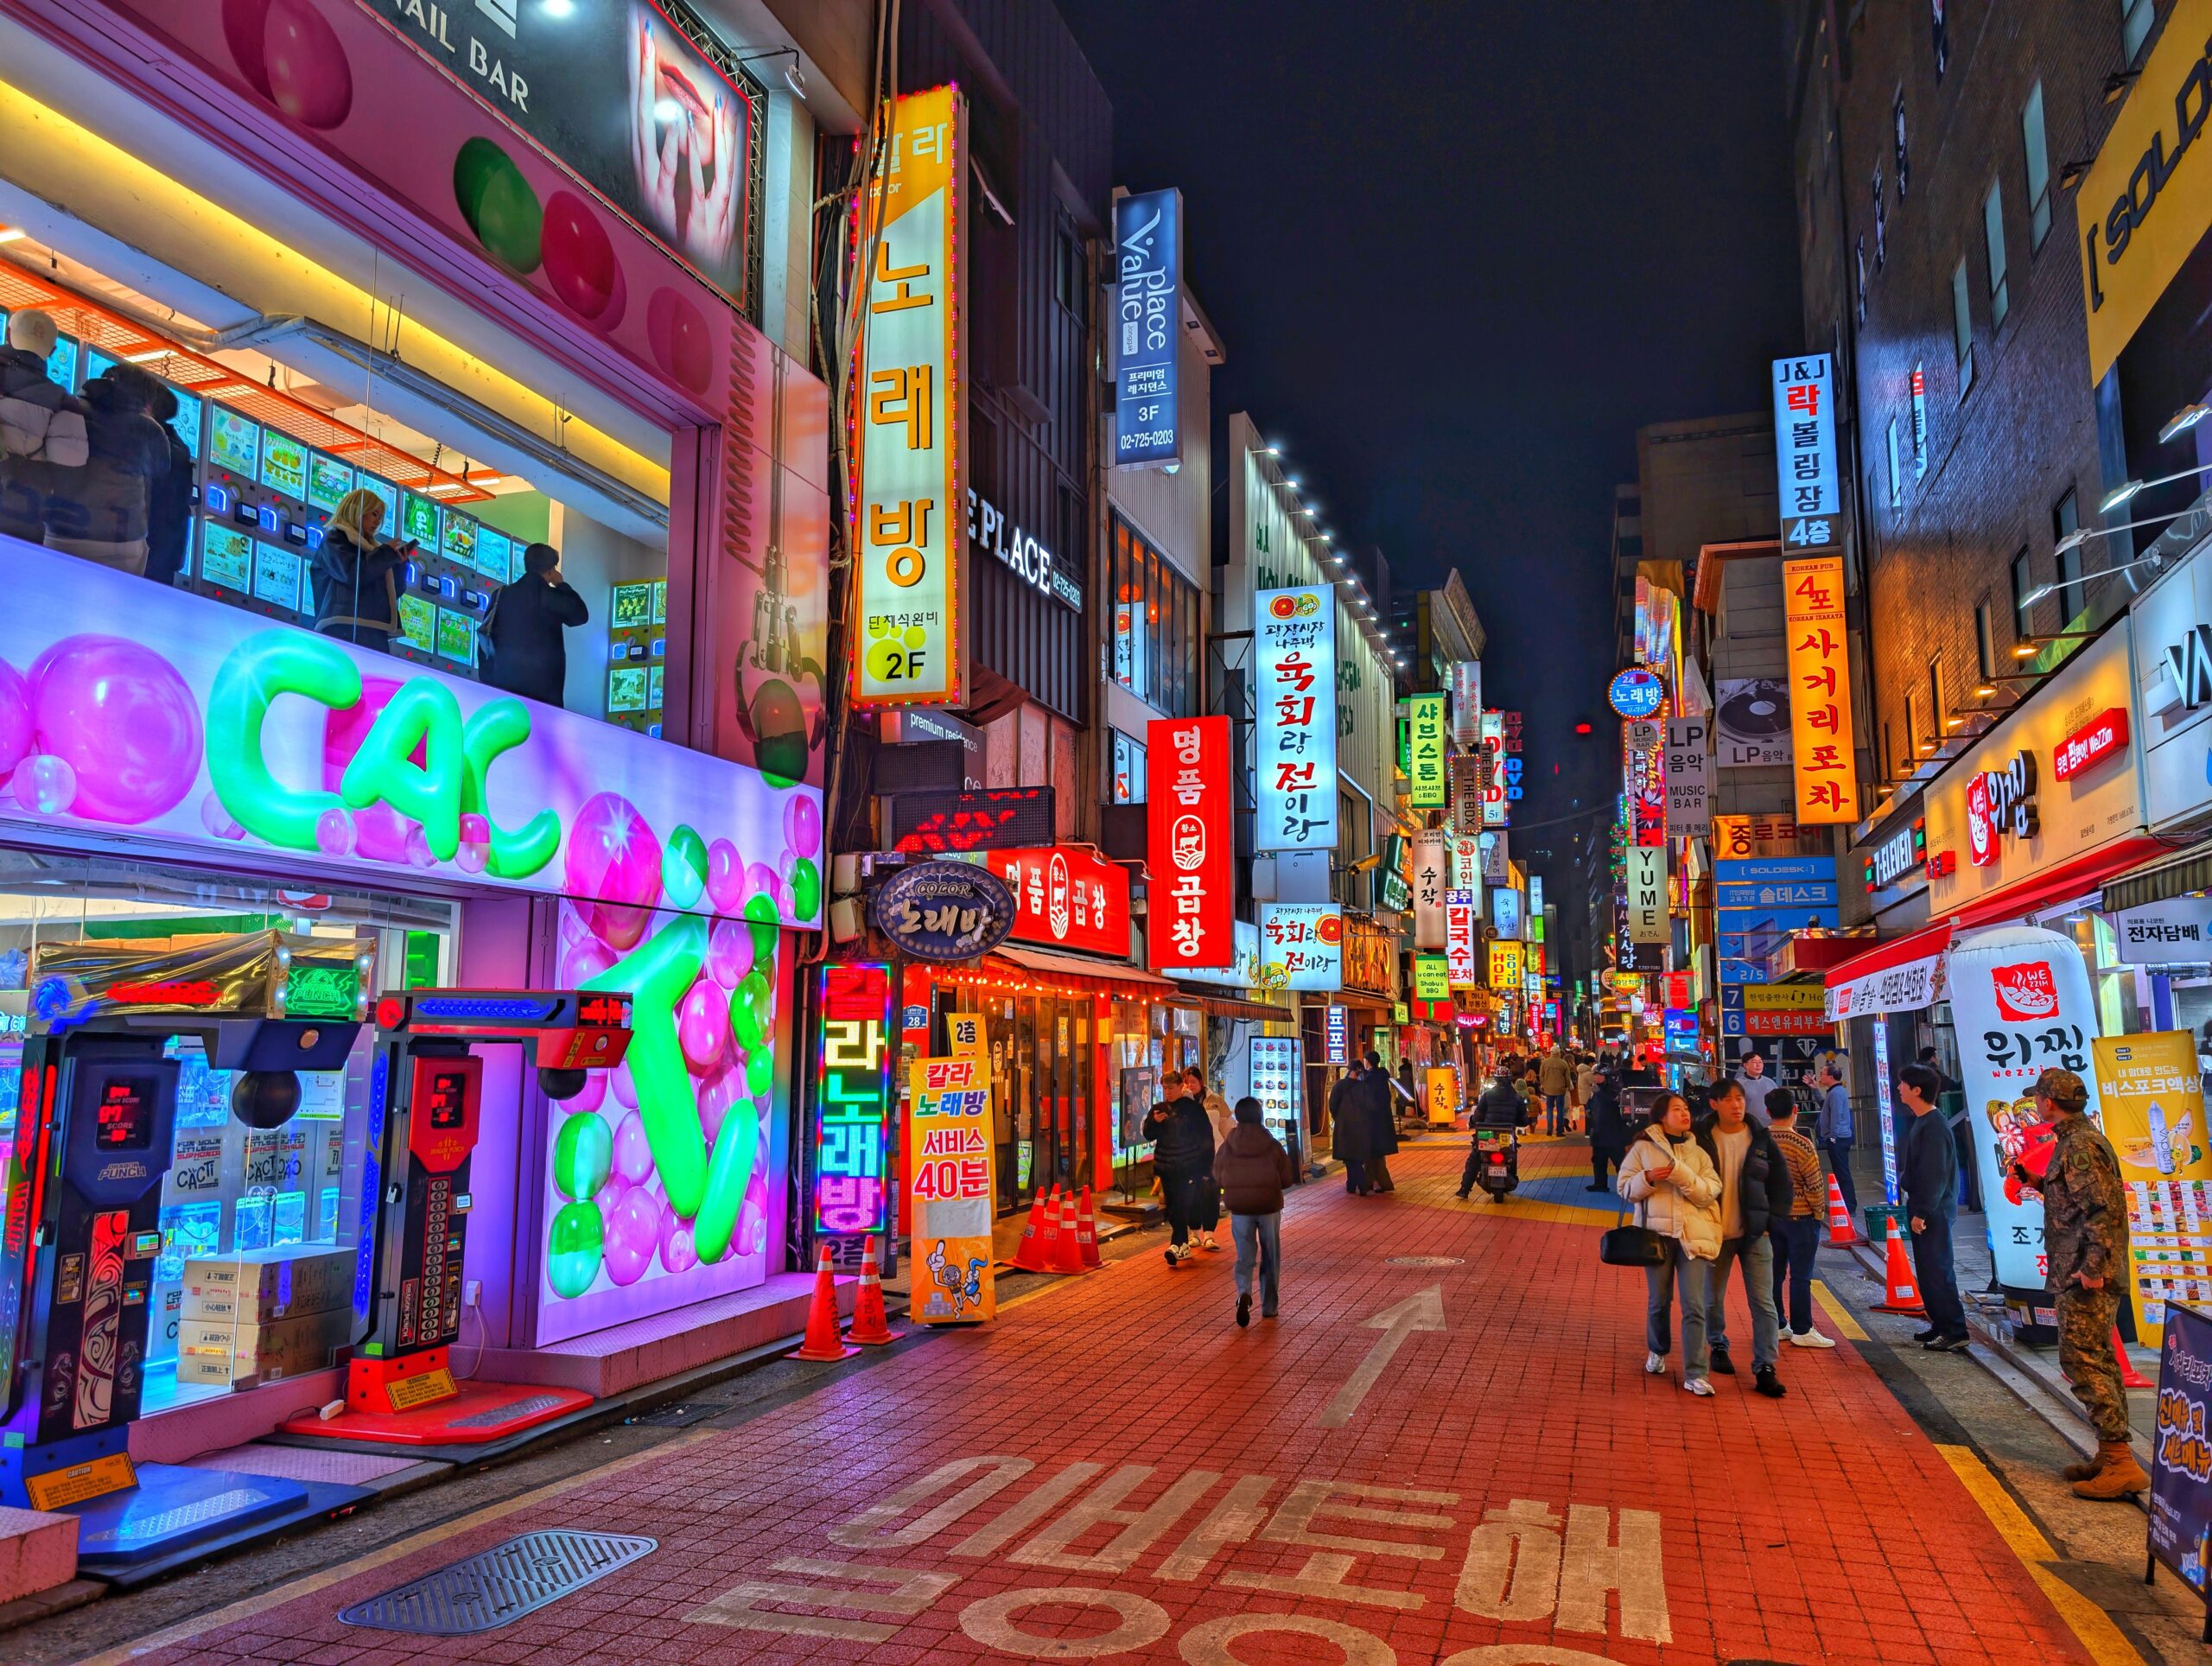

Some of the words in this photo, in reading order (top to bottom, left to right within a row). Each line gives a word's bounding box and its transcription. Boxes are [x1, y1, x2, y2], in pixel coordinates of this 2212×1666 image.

[394, 0, 455, 54] AIL
[468, 36, 530, 113] BAR
[869, 181, 902, 198] coor
[1121, 207, 1161, 321] Value
[1146, 264, 1176, 351] place
[1128, 367, 1166, 383] 프리미엄
[1778, 359, 1826, 384] J&J
[1127, 380, 1168, 396] 레지던스
[870, 239, 935, 588] 노래방
[1138, 404, 1160, 423] 3F
[1120, 429, 1174, 450] 02-725-0203
[1789, 518, 1831, 546] 4층
[979, 499, 1052, 596] PLACE
[1790, 564, 1819, 573] KOREAN
[1052, 570, 1082, 608] 02-725-0203
[868, 610, 939, 631] 단체석완비
[1815, 613, 1845, 621] IZAKAYA
[1265, 620, 1325, 639] 광장시장
[1274, 635, 1316, 649] 나주댁
[885, 651, 927, 680] 2F
[1622, 675, 1635, 685] 24
[1613, 686, 1660, 706] 노래방
[910, 711, 945, 741] premium
[1795, 628, 1850, 813] 사거리포차
[1634, 726, 1651, 737] LP
[1669, 725, 1705, 747] LP
[1417, 703, 1440, 782] 샤브스톤
[1171, 724, 1207, 806] 명품
[1481, 745, 1491, 766] THE
[1668, 754, 1705, 773] 음악
[1732, 747, 1761, 764] LP
[1761, 749, 1784, 762] 음악
[2057, 753, 2069, 777] 우린
[1464, 775, 1475, 798] THE
[1481, 767, 1492, 787] BOX
[1506, 758, 1523, 800] DVD
[1669, 785, 1706, 798] MUSIC
[1464, 802, 1476, 825] BOX
[1674, 797, 1702, 810] BAR
[1487, 810, 1501, 819] 5F
[1179, 823, 1198, 833] 황소
[1873, 828, 1913, 887] 7-ELEVEN
[1459, 857, 1473, 886] 코인
[915, 881, 975, 900] COLOR
[1420, 866, 1439, 907] 수작
[1639, 850, 1656, 926] YUME
[1758, 886, 1828, 904] 솔데스크
[1072, 879, 1107, 931] 곱창
[1446, 891, 1472, 904] 공주
[1170, 874, 1208, 957] 곱창
[1264, 916, 1319, 946] 육회랑
[1447, 907, 1471, 966] 칼국수
[2126, 924, 2200, 944] 전자담배
[1285, 951, 1338, 974] 전이랑
[1493, 953, 1504, 984] HOF
[1506, 953, 1516, 985] SOJU
[1447, 968, 1473, 981] 포차
[2027, 969, 2048, 981] WE
[2029, 979, 2049, 989] ZZIM
[294, 987, 341, 1002] PUNCH
[1727, 990, 1739, 1005] 7
[1749, 993, 1789, 1003] 한림출판사
[908, 1016, 920, 1027] 28
[956, 1020, 976, 1044] 2층
[1668, 1020, 1681, 1031] 24
[1727, 1014, 1741, 1031] 6
[1749, 1015, 1826, 1031] 에스앤유피부과
[1983, 1024, 2088, 1073] 위찜
[926, 1062, 975, 1090] 칼라
[1993, 1065, 2058, 1078] wezzi
[2118, 1067, 2126, 1078] 내
[2128, 1065, 2153, 1078] 말대로
[2153, 1065, 2180, 1077] 만드는
[1433, 1082, 1446, 1108] 수작
[2101, 1074, 2199, 1099] 비스포크액상
[914, 1091, 988, 1117] 노래방
[922, 1129, 986, 1155] 서비스
[97, 1166, 147, 1181] PUNCH
[107, 1161, 139, 1170] DRAGON
[913, 1160, 990, 1199] 40분
[2192, 1405, 2204, 1432] 및
[67, 1466, 92, 1479] CAUTION
